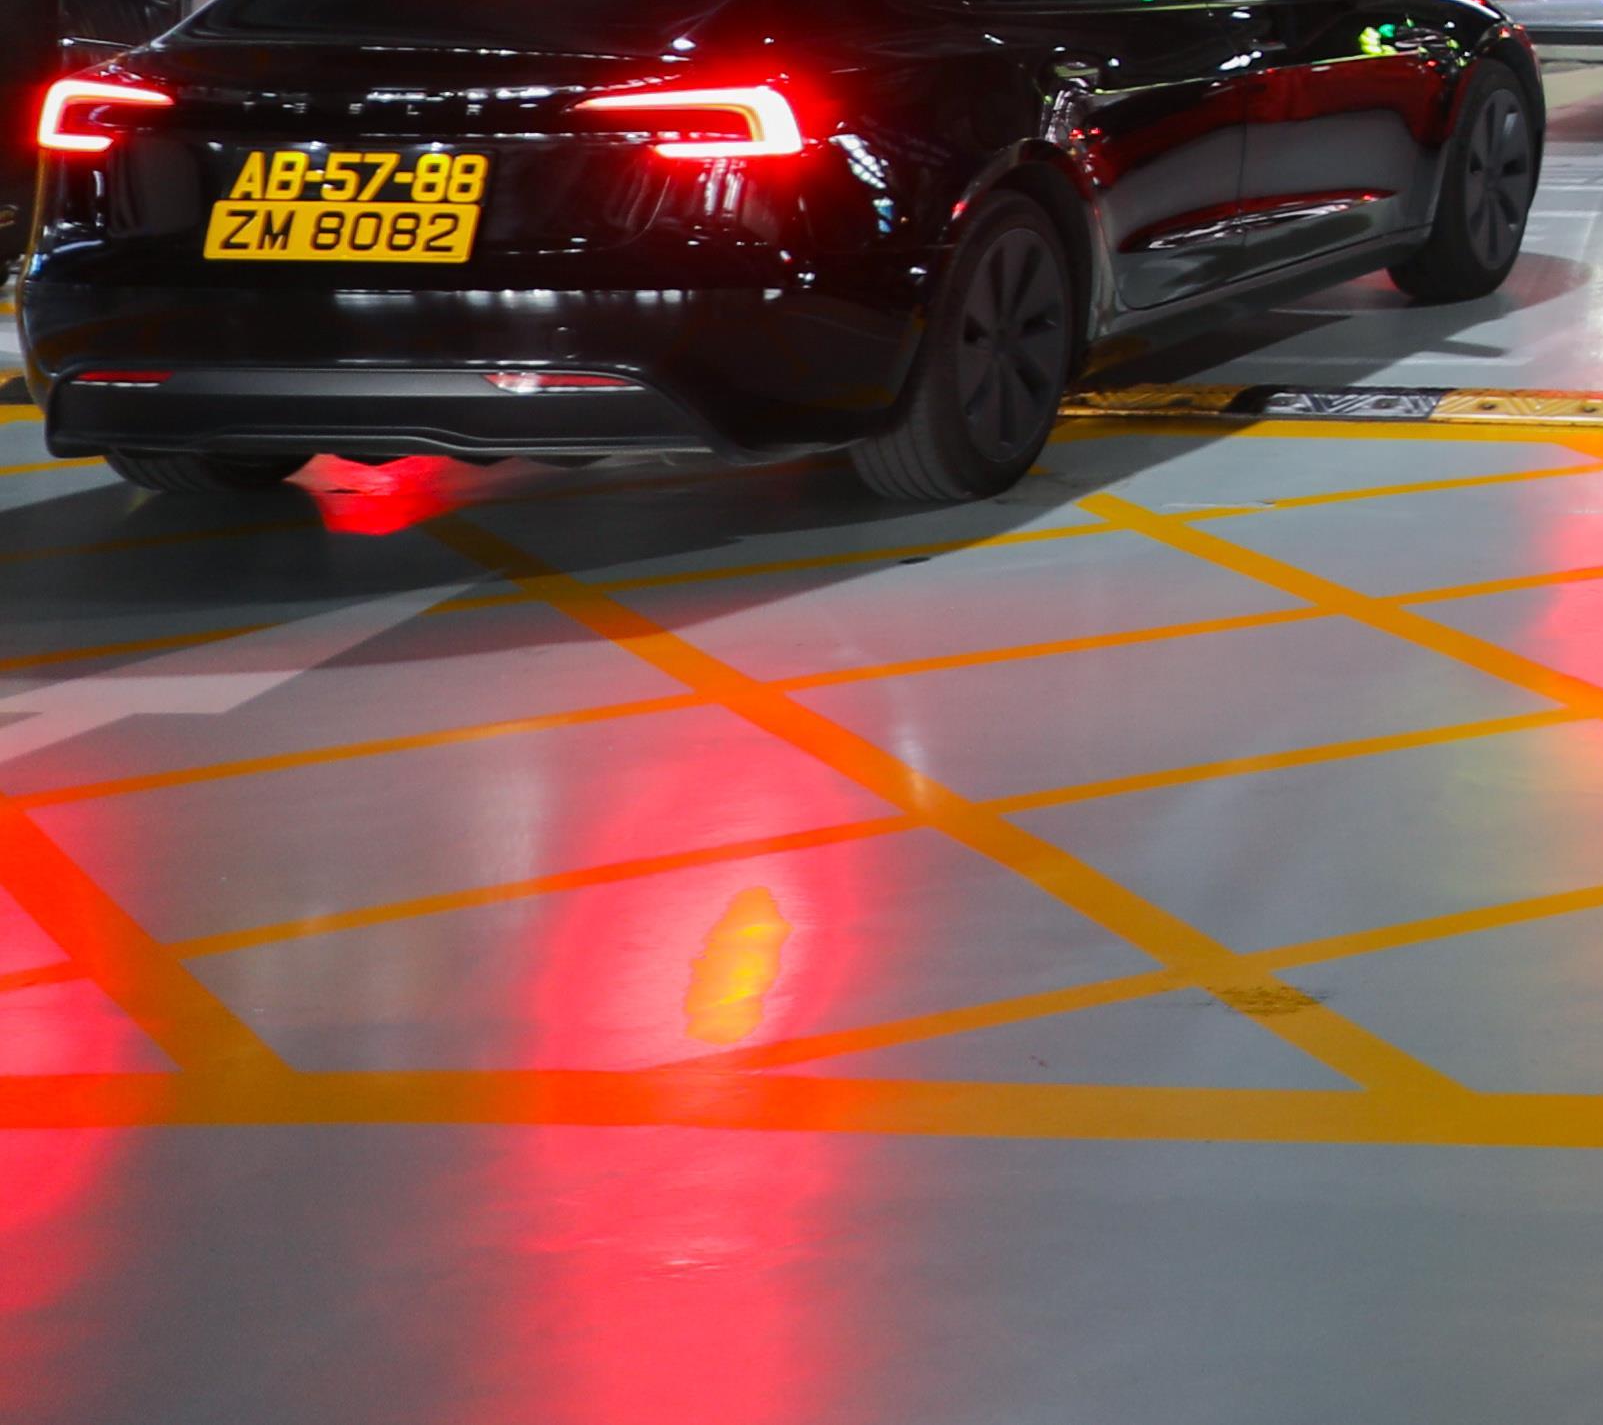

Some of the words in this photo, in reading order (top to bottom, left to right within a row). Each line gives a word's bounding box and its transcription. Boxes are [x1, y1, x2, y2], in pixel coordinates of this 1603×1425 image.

[228, 151, 489, 203] AB-57-88
[219, 209, 295, 250] ZM
[310, 211, 459, 252] 8082
